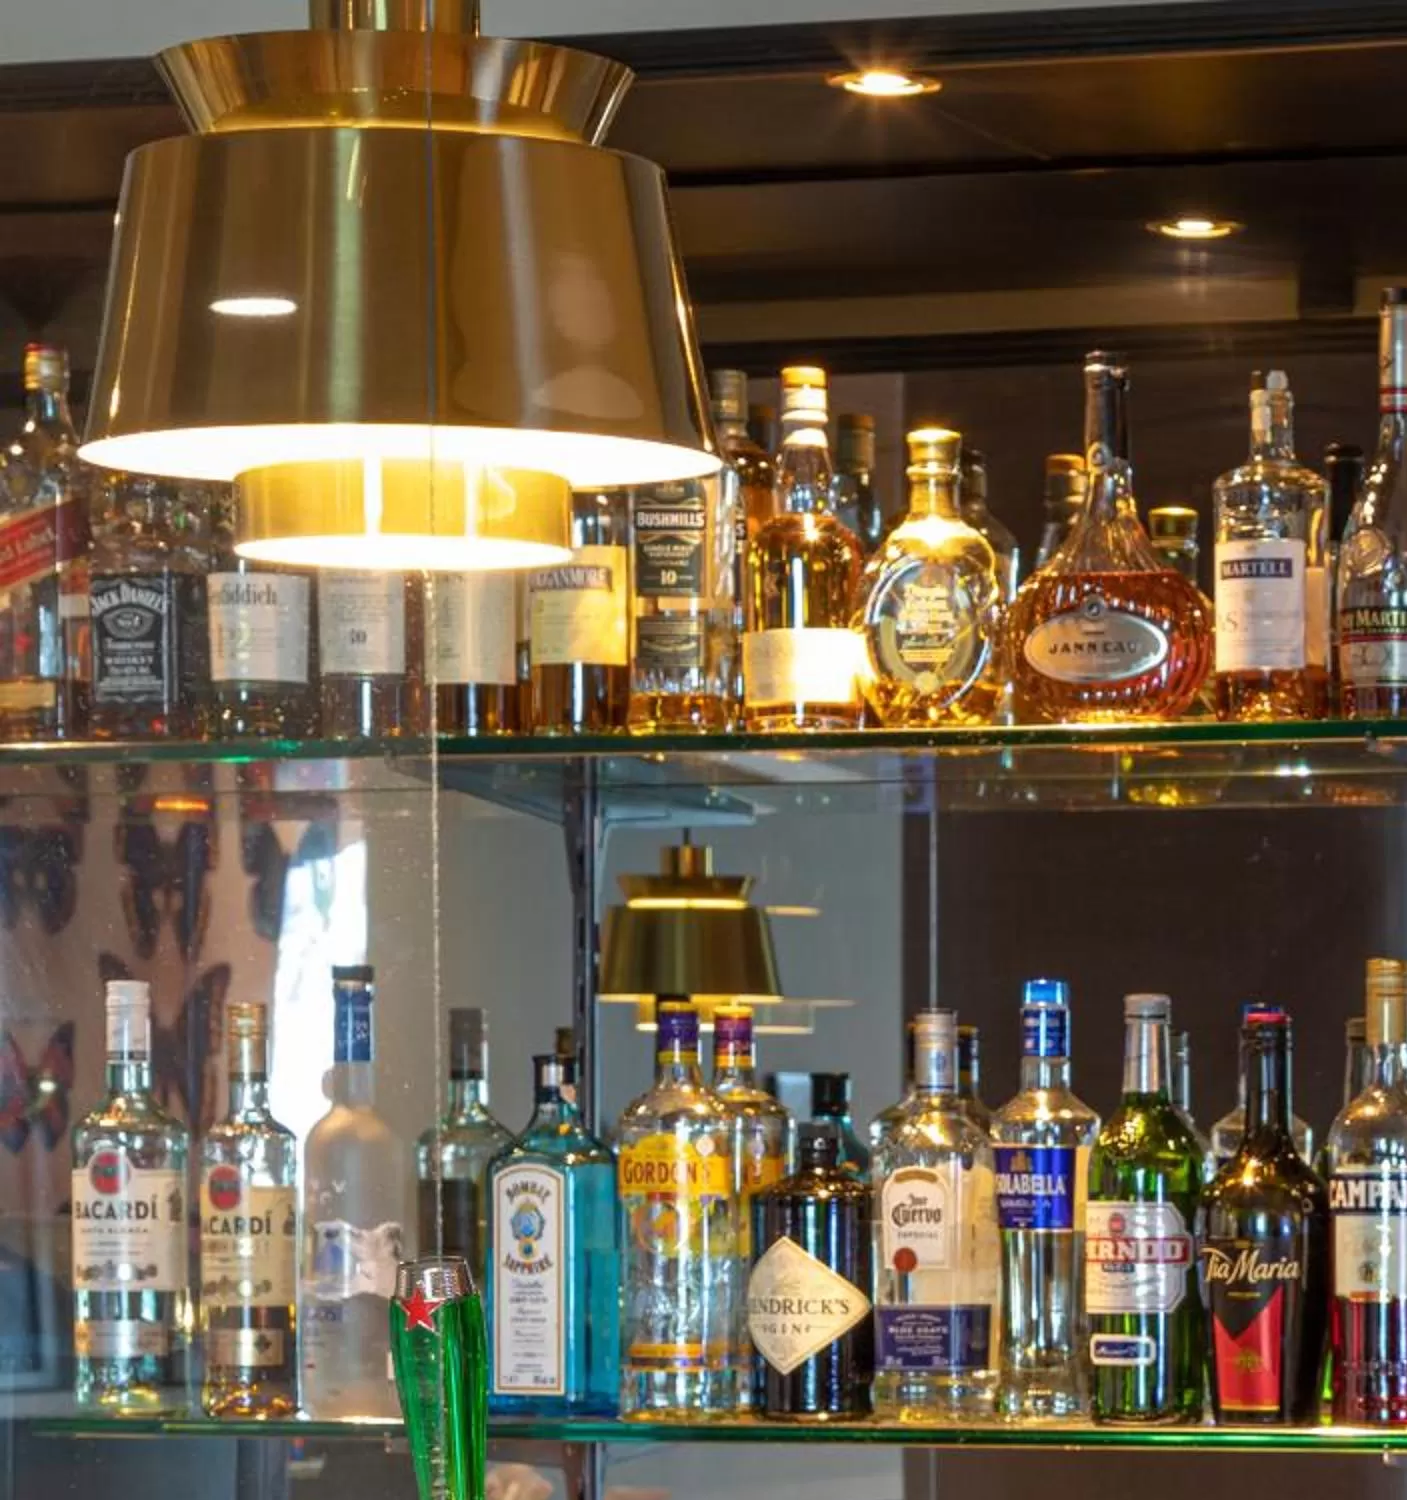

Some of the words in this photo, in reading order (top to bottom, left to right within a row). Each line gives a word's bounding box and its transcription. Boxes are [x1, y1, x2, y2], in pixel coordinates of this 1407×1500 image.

[637, 511, 705, 528] BUSHMILLS
[661, 568, 678, 585] 10
[1222, 560, 1289, 576] MARTELL
[1048, 640, 1137, 656] JANNEAU
[892, 1202, 943, 1228] Cuervo
[1201, 1247, 1233, 1283] Tia
[1224, 1249, 1300, 1285] Maria
[752, 1298, 850, 1315] NDRICK'S
